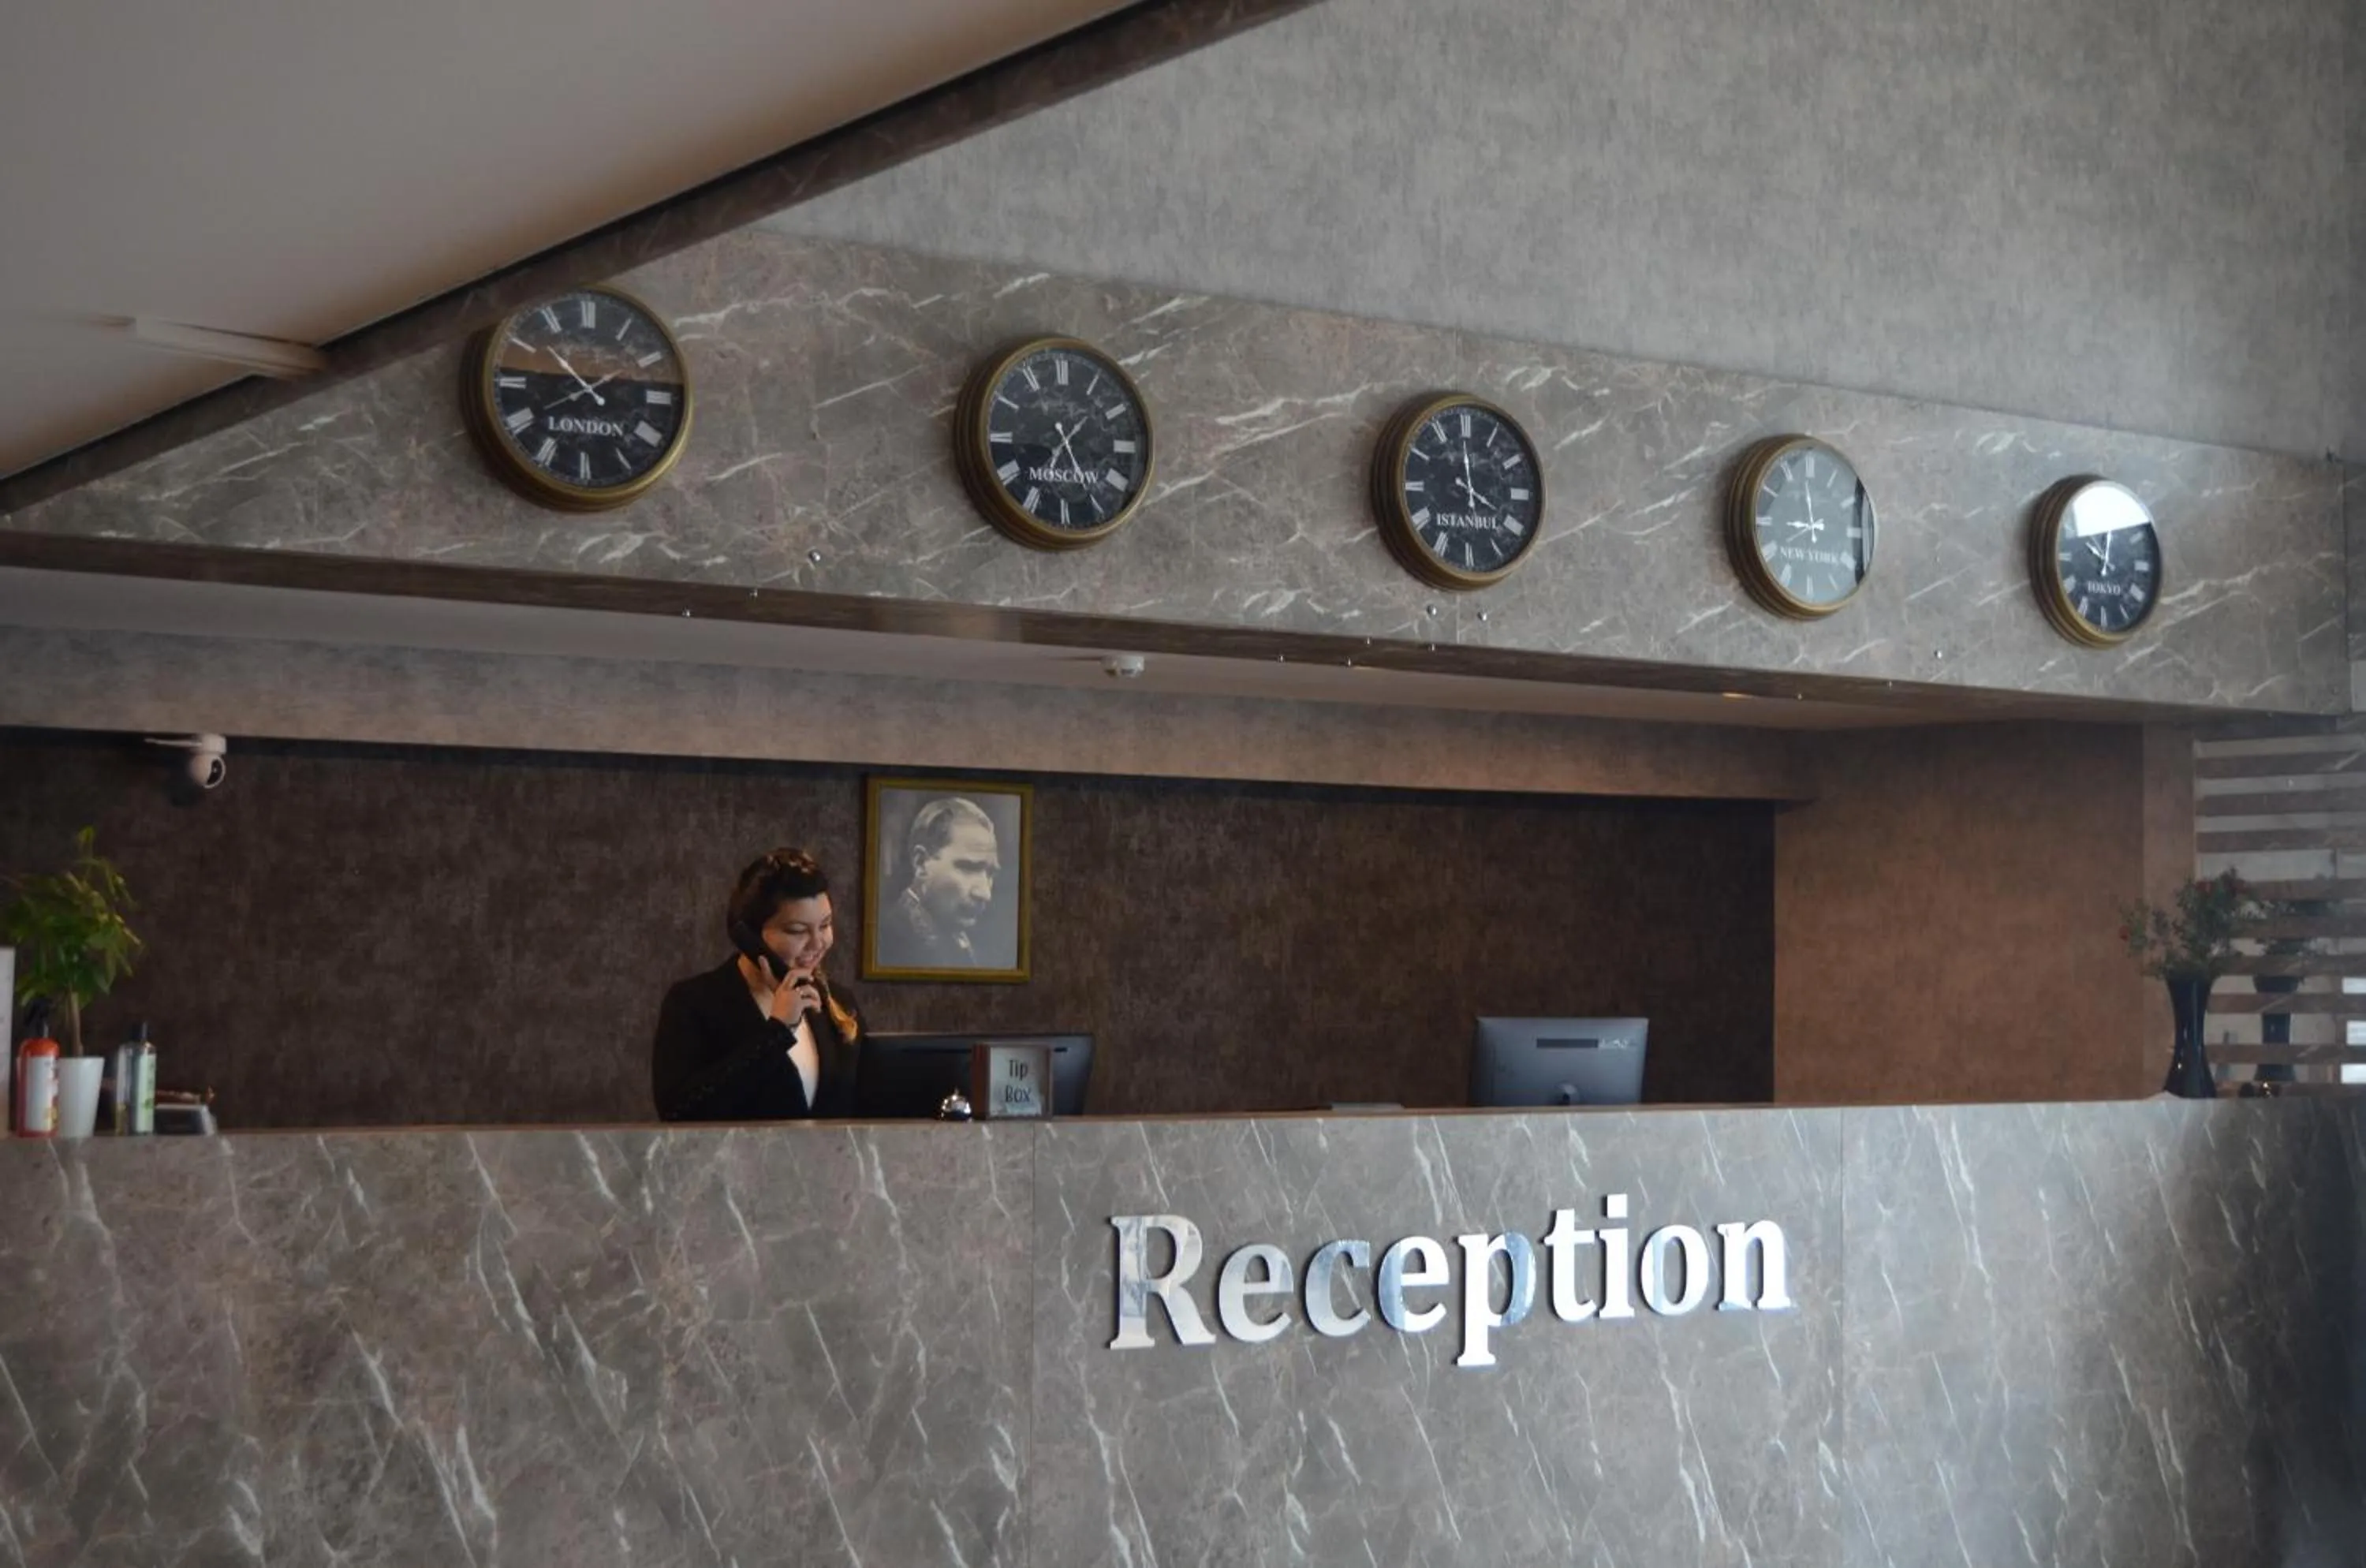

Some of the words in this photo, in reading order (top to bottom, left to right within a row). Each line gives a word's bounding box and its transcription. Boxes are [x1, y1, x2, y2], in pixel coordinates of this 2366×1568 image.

[548, 416, 623, 436] LONDON
[1028, 467, 1099, 484] MOSCOW
[1436, 513, 1498, 530] ISTANBUL
[1780, 546, 1804, 562] NEW
[1807, 547, 1840, 566] YORK
[2088, 581, 2121, 595] TOKYO
[1009, 1059, 1028, 1081] Tip
[1109, 1193, 1796, 1368] Reception
